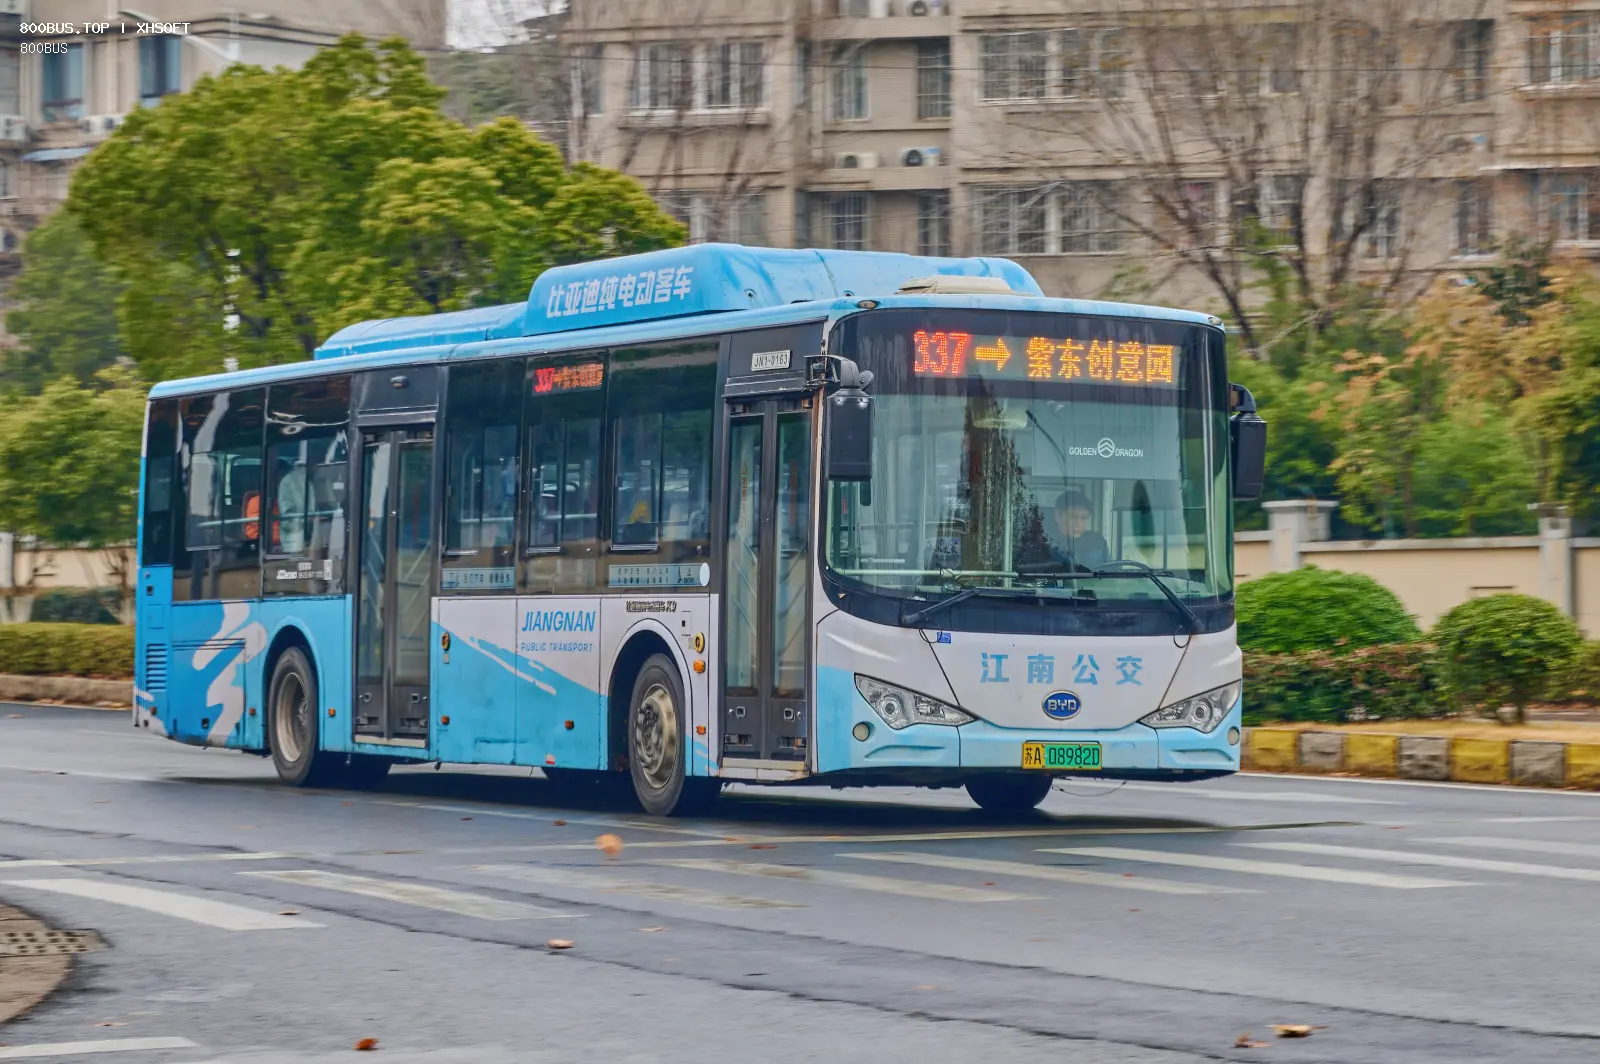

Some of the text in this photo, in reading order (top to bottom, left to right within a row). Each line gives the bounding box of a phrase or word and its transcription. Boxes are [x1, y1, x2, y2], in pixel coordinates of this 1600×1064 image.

[546, 264, 694, 318] 比亚迪纯电动客车
[914, 330, 969, 374] 337
[1026, 336, 1175, 383] 紫东创意园
[1068, 446, 1144, 458] GOLDEN DRAGON
[521, 610, 597, 632] JIANGNAN
[520, 642, 593, 652] PUBLIC TRANSPORT
[979, 652, 1144, 686] 江南公交
[1047, 699, 1077, 711] BYD
